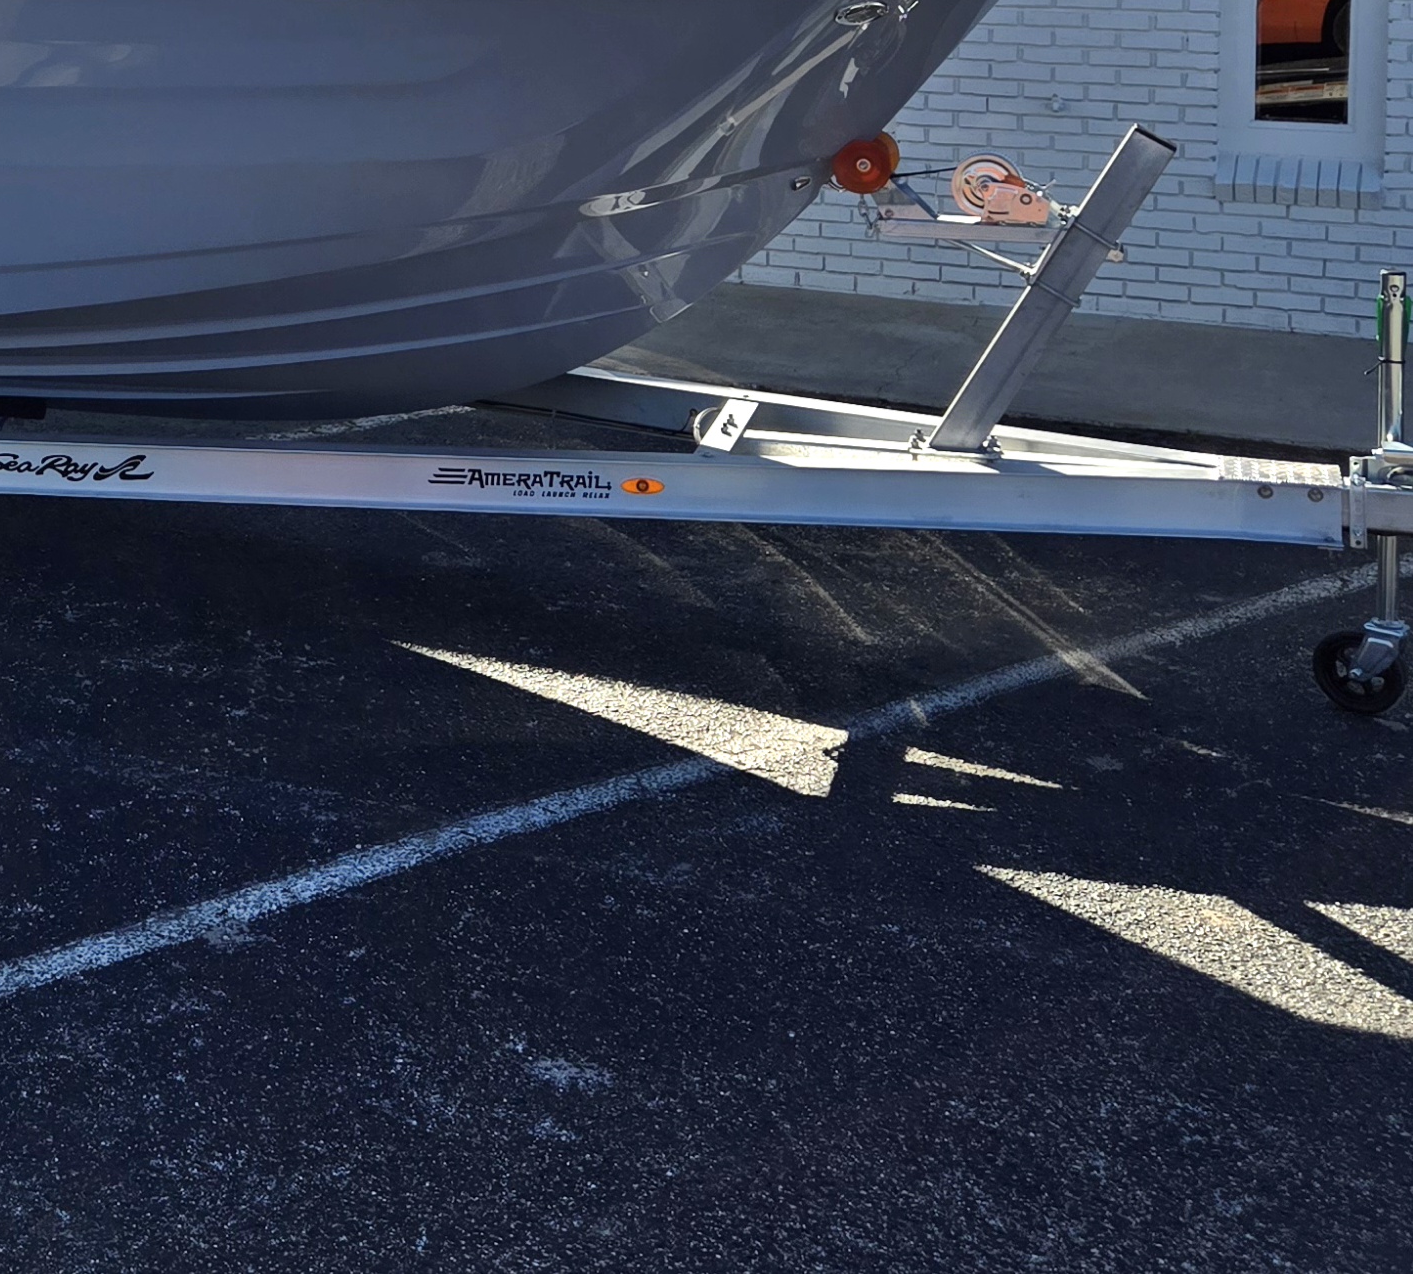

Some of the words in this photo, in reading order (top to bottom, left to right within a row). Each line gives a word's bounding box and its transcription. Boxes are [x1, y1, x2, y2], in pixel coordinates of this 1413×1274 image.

[35, 454, 98, 482] Ray
[512, 489, 535, 497] LOAD
[541, 490, 576, 498] LAUNCH
[582, 491, 610, 499] RELAX
